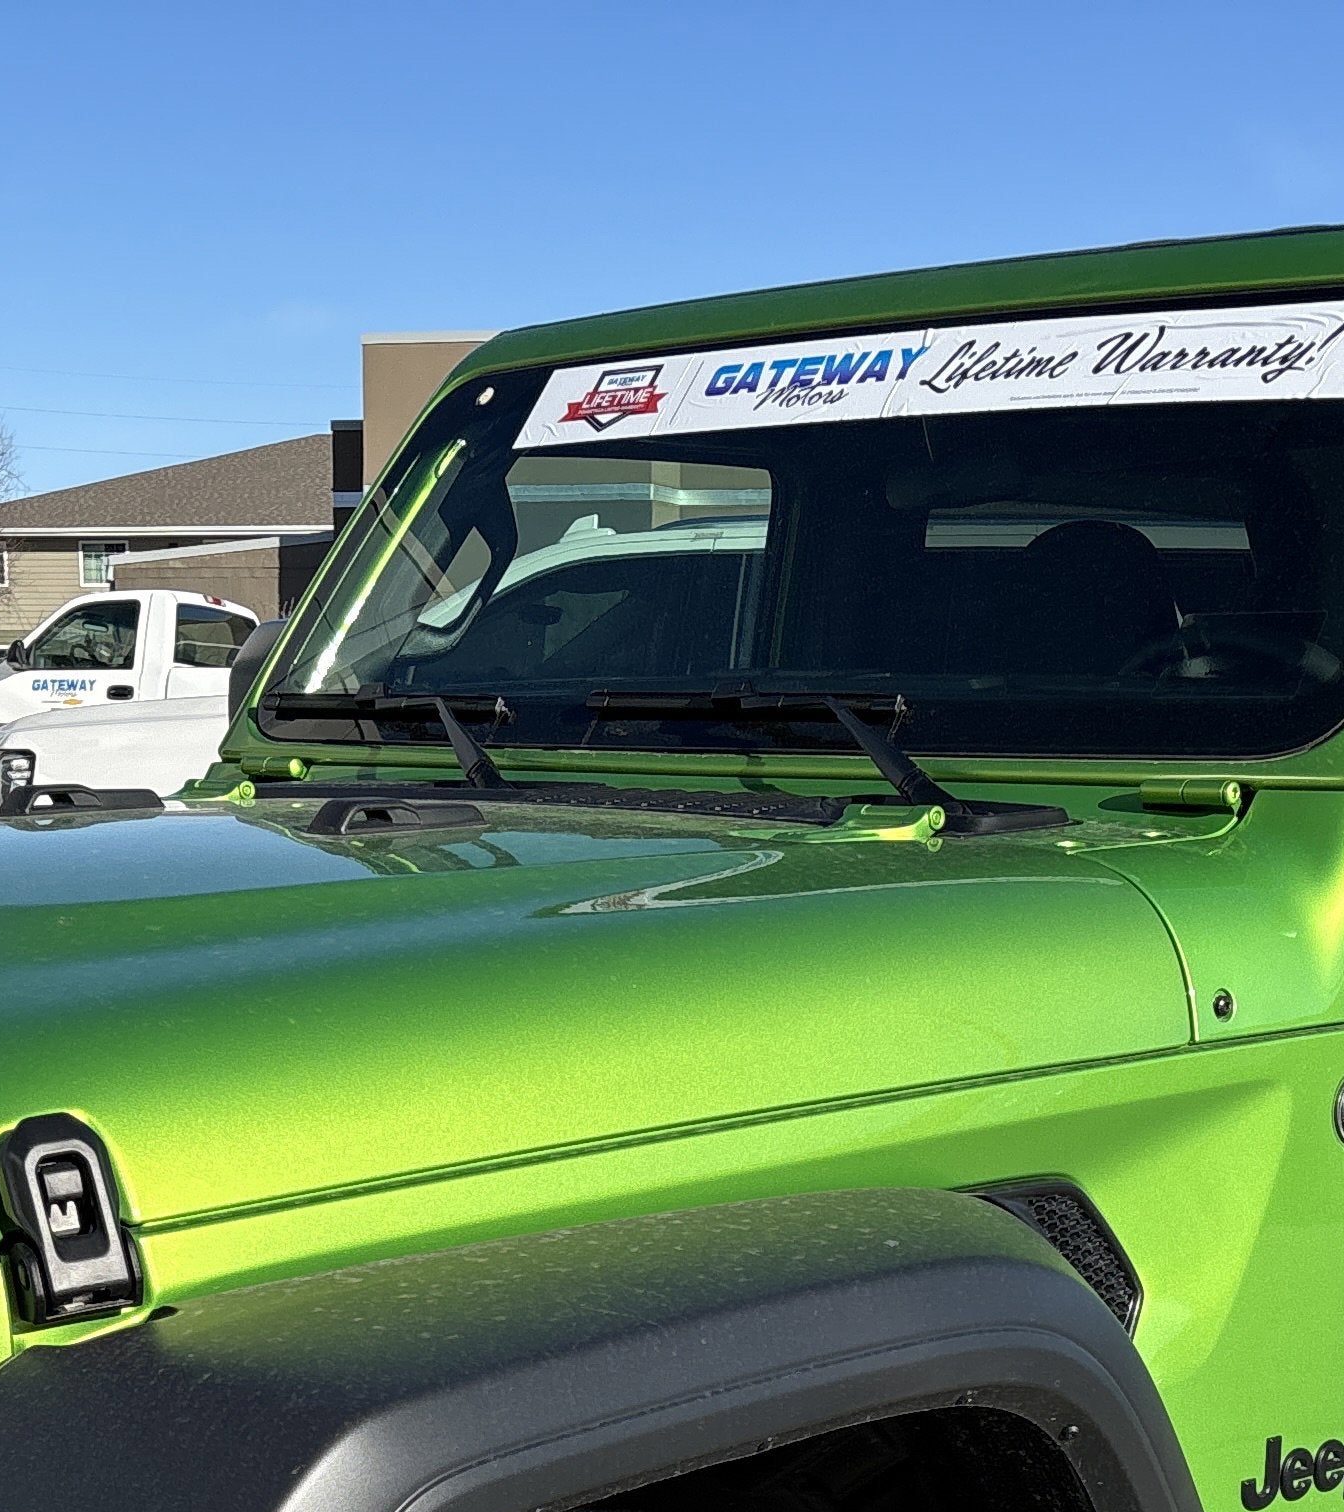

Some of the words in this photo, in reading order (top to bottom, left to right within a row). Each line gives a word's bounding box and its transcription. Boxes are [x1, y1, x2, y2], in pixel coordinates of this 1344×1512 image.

[705, 346, 929, 396] GATEWAY
[919, 340, 1079, 394] Lifetime
[582, 387, 654, 409] LIFETIME
[753, 380, 849, 411] Motors
[32, 679, 97, 691] GATEWAY
